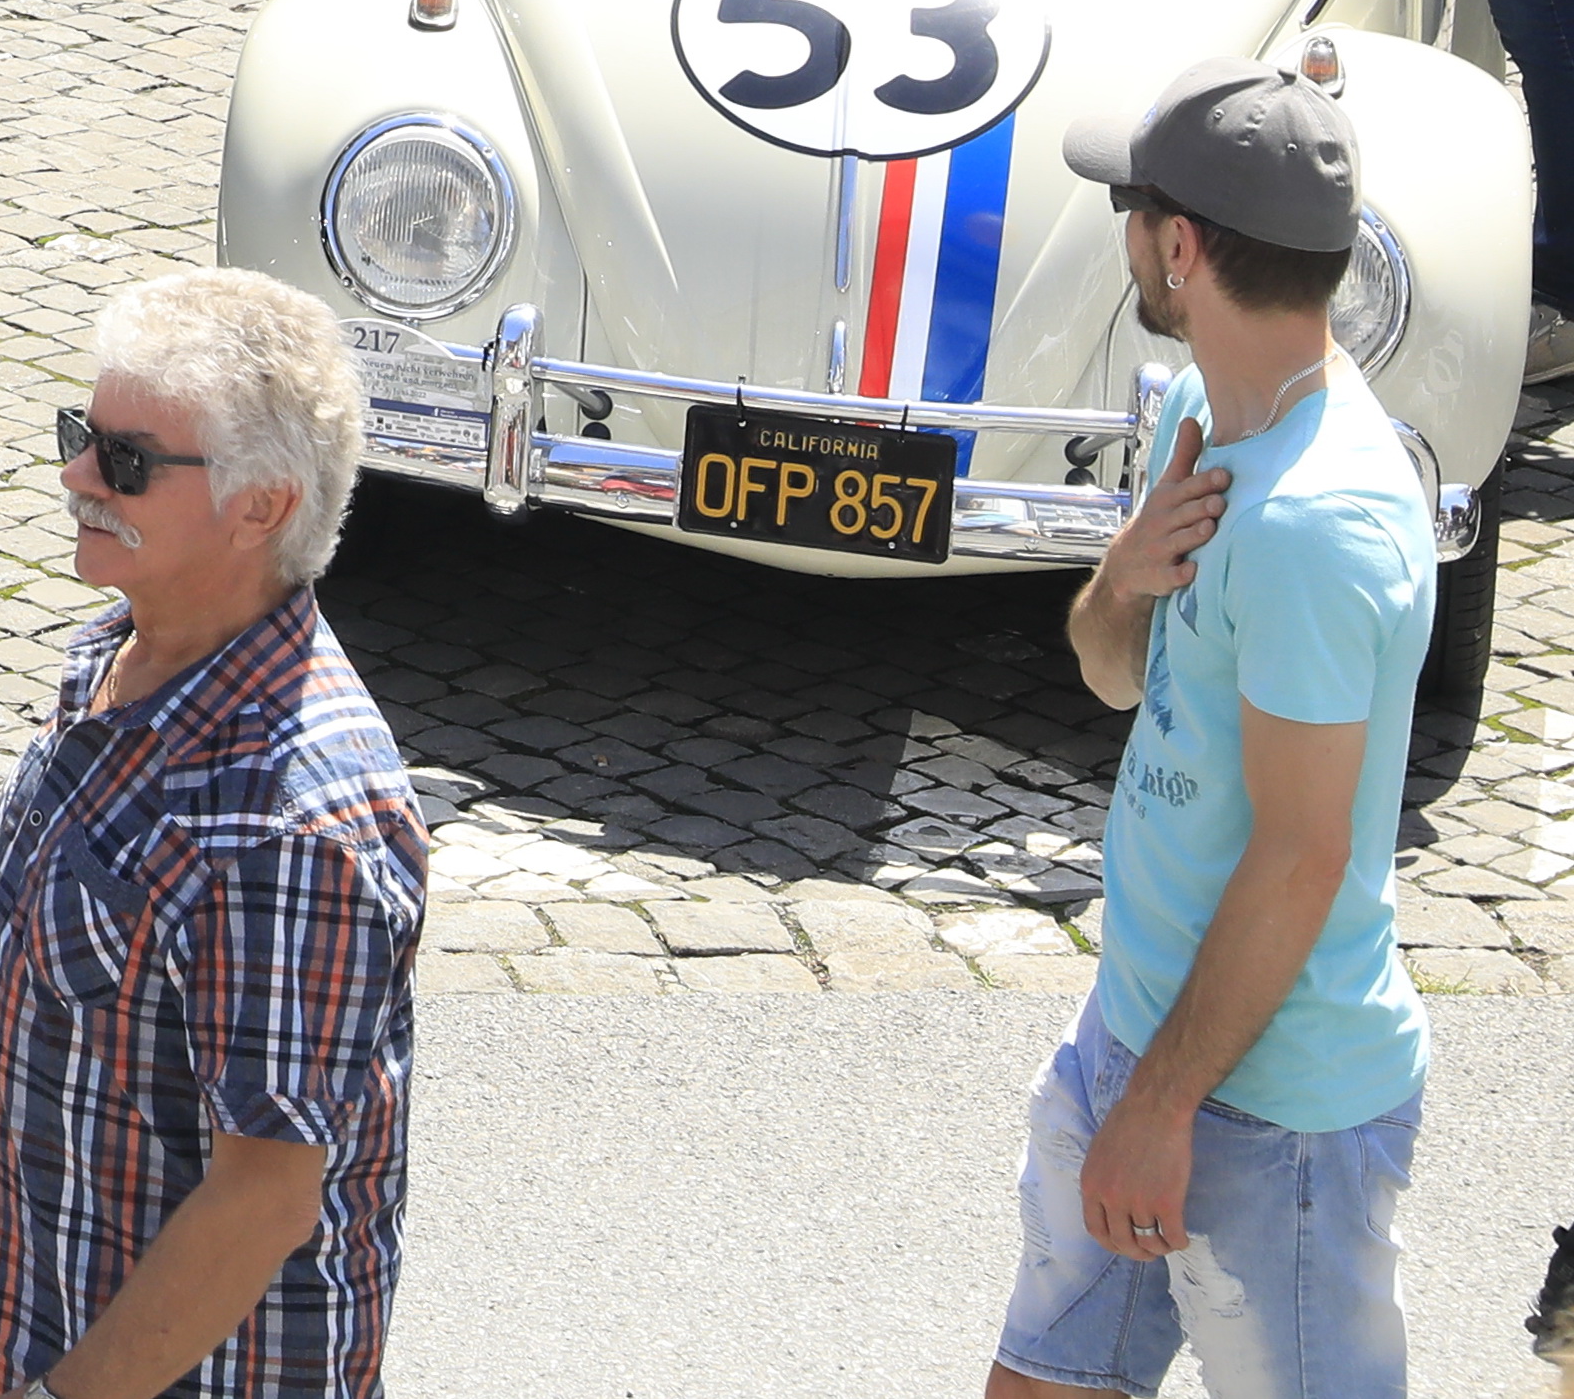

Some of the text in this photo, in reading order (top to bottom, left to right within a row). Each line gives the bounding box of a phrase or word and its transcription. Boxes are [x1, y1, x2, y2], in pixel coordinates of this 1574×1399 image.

[353, 326, 401, 353] 217
[760, 429, 879, 460] CALIFORNIA
[695, 452, 938, 544] OFP 857
[1138, 763, 1202, 808] high
